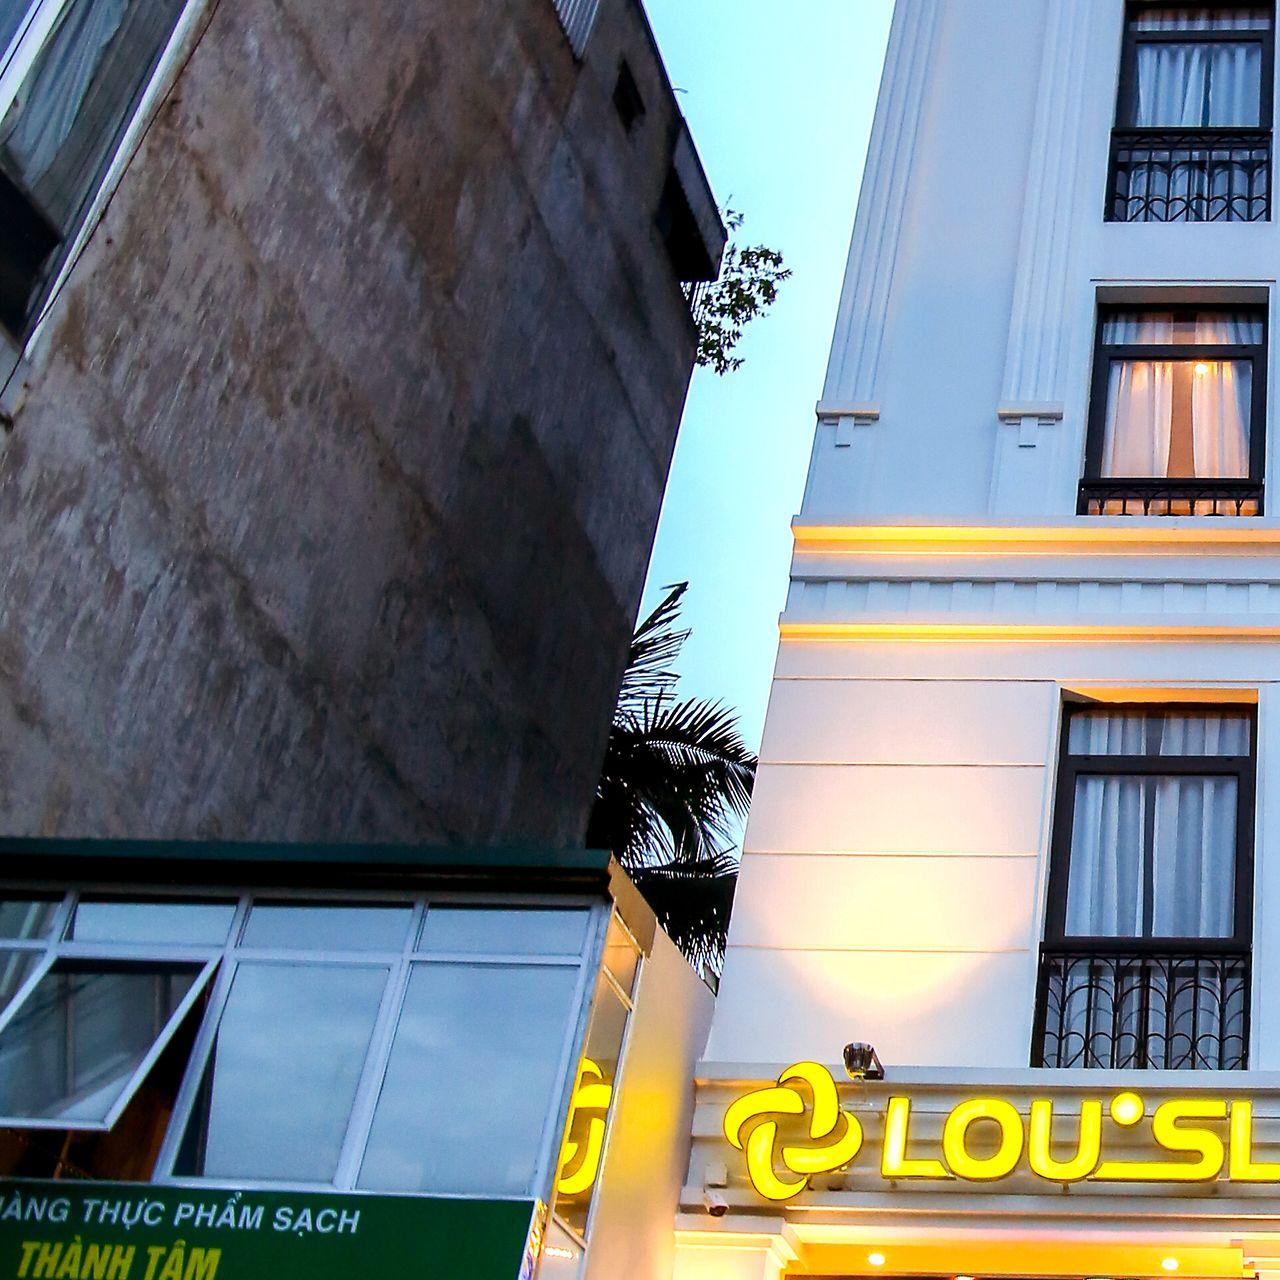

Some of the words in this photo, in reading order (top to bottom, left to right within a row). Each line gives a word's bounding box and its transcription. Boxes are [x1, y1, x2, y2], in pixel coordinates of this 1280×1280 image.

[0, 1190, 71, 1222] ÀNG
[83, 1198, 165, 1231] THỰC
[173, 1191, 265, 1231] PHẨM
[272, 1206, 361, 1237] SẠCH
